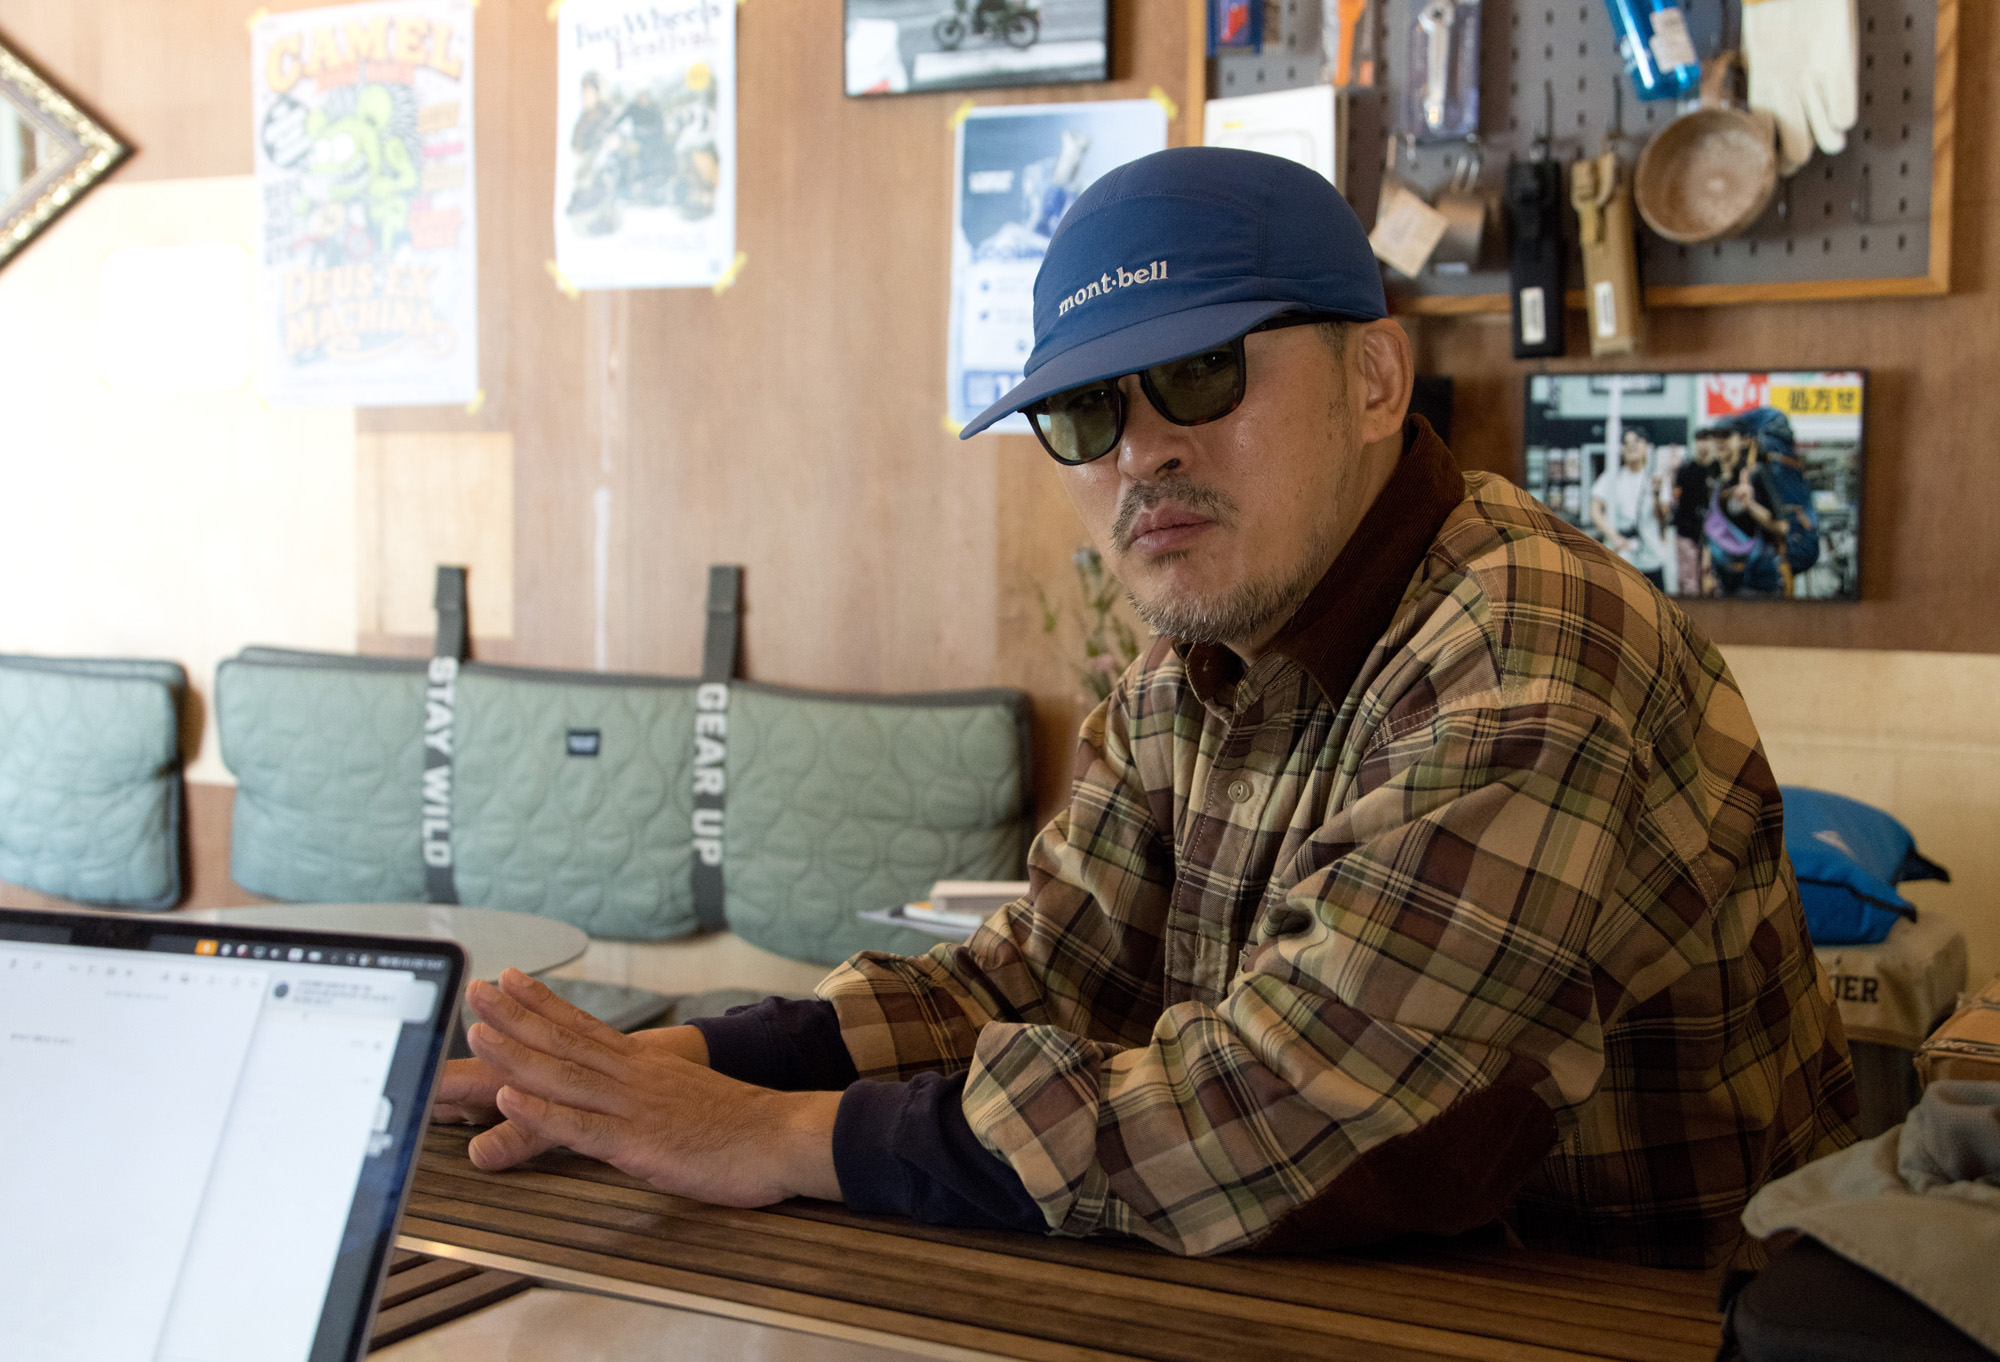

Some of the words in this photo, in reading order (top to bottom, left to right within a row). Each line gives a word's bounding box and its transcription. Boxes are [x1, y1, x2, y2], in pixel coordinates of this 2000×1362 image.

[264, 14, 463, 94] CAMEL
[283, 264, 375, 312] DEUS
[385, 265, 437, 299] EX
[284, 298, 437, 358] MACHINA
[424, 656, 459, 754] STAY
[692, 682, 729, 797] GEAR
[422, 766, 454, 868] WILD
[691, 808, 726, 866] UP
